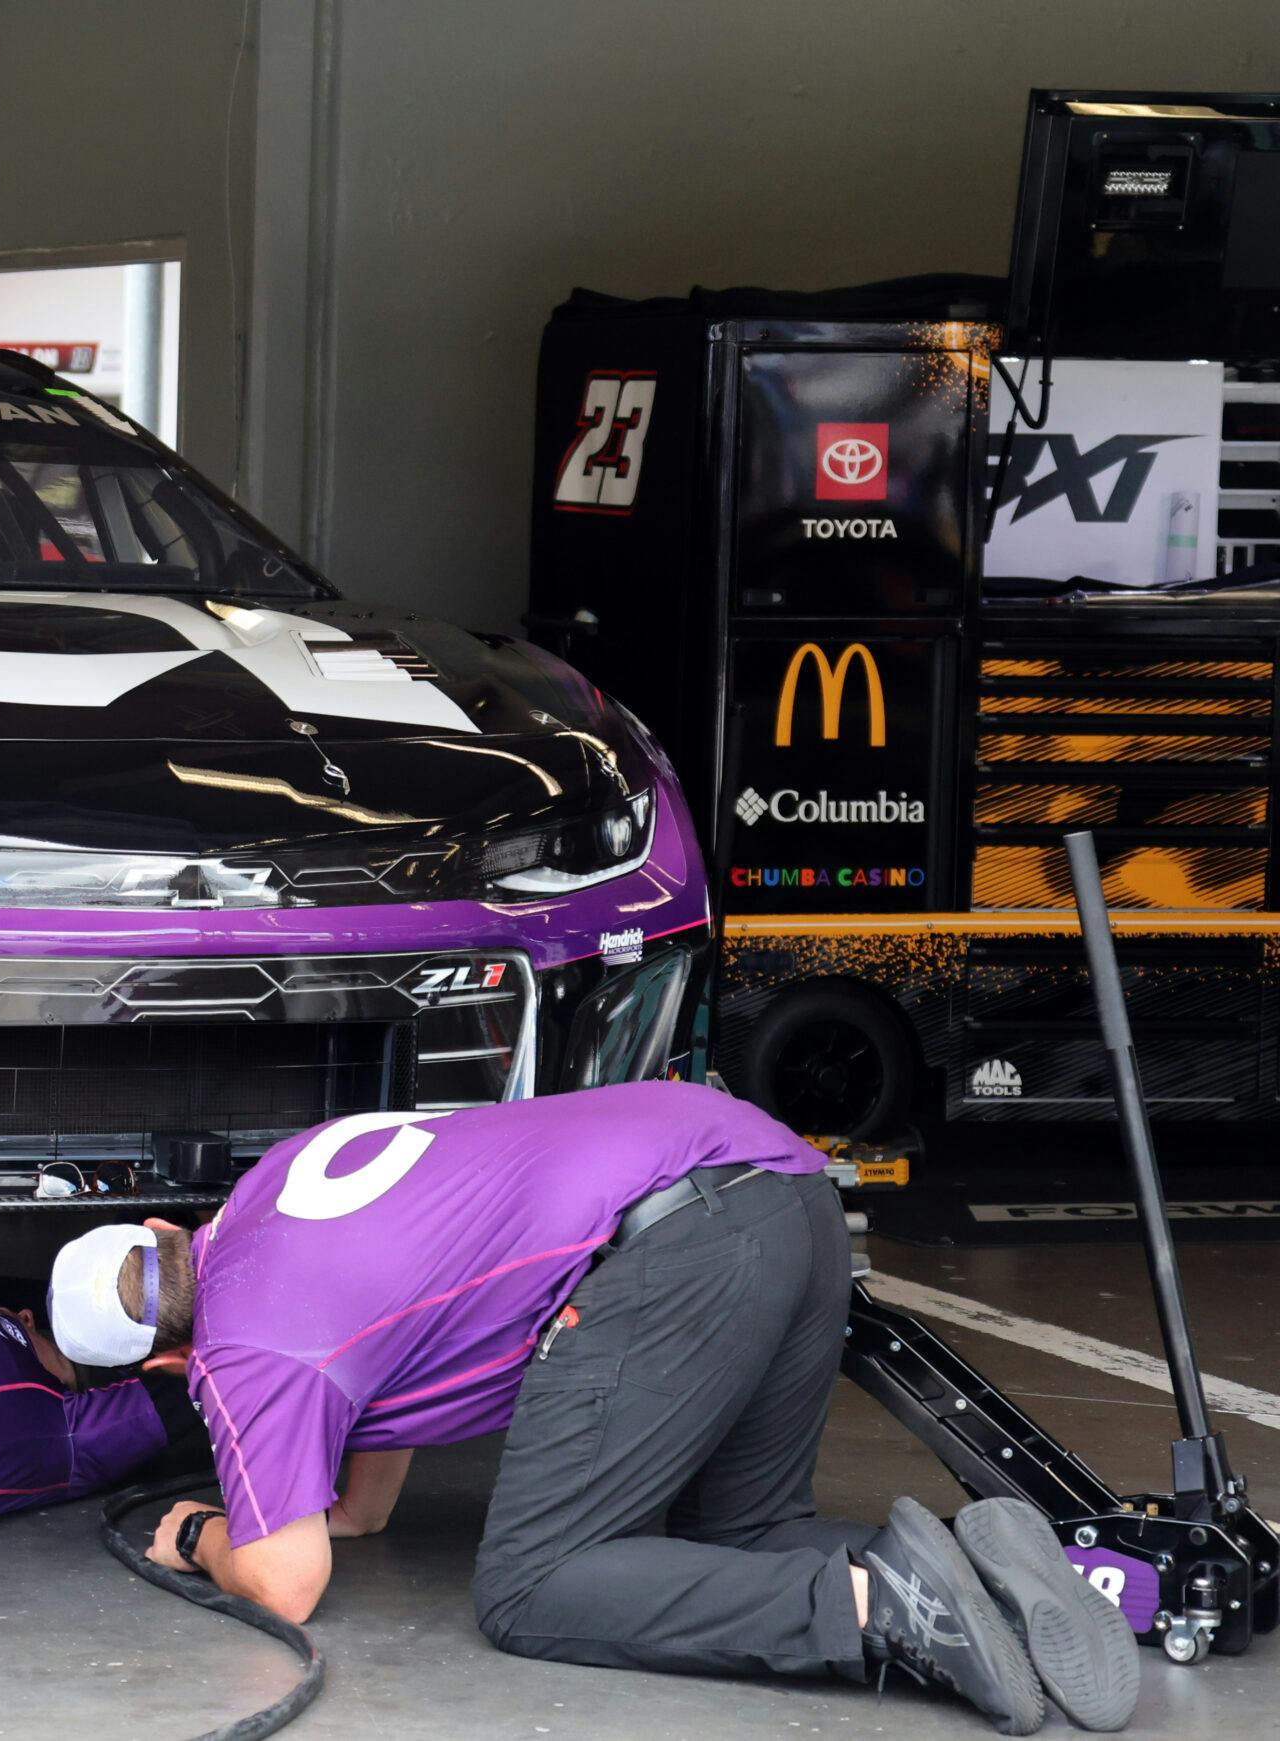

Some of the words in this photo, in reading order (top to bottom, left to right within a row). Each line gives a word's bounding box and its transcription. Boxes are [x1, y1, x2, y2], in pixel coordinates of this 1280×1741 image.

[554, 371, 657, 514] 23
[802, 518, 898, 539] TOYOTA
[770, 789, 925, 823] Columbia
[730, 867, 831, 887] CHUMBA
[837, 867, 926, 887] CASINO
[599, 927, 644, 955] Hendrick
[410, 963, 507, 994] ZL1
[972, 1058, 1022, 1086] MAC
[972, 1086, 1022, 1096] TOOLS
[1071, 1564, 1126, 1608] 8
